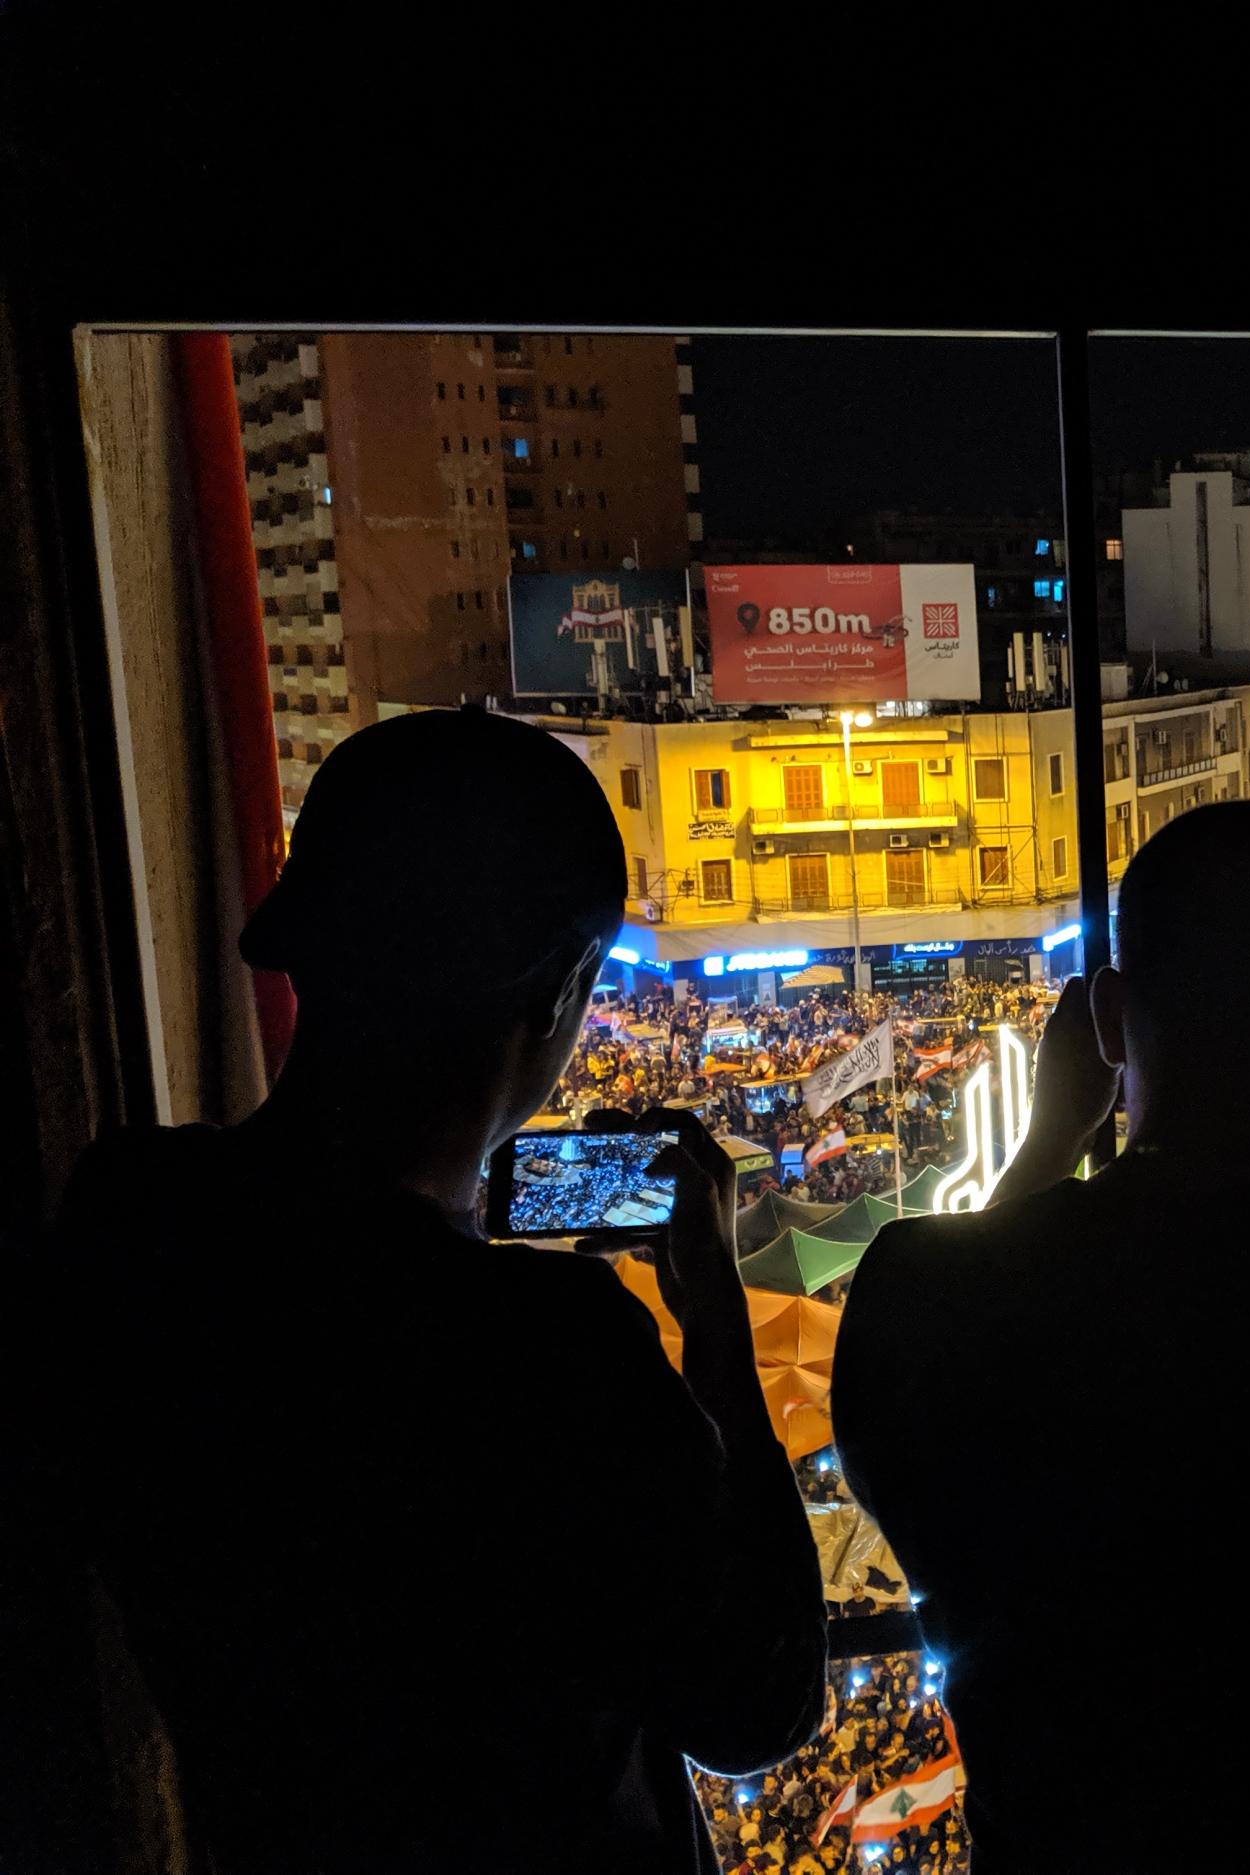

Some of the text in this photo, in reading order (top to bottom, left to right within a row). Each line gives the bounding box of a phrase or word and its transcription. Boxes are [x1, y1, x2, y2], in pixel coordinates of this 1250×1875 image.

[768, 607, 872, 635] 850m
[744, 643, 874, 659] مركز كاريتاس الصحي
[995, 940, 1018, 955] رأس
